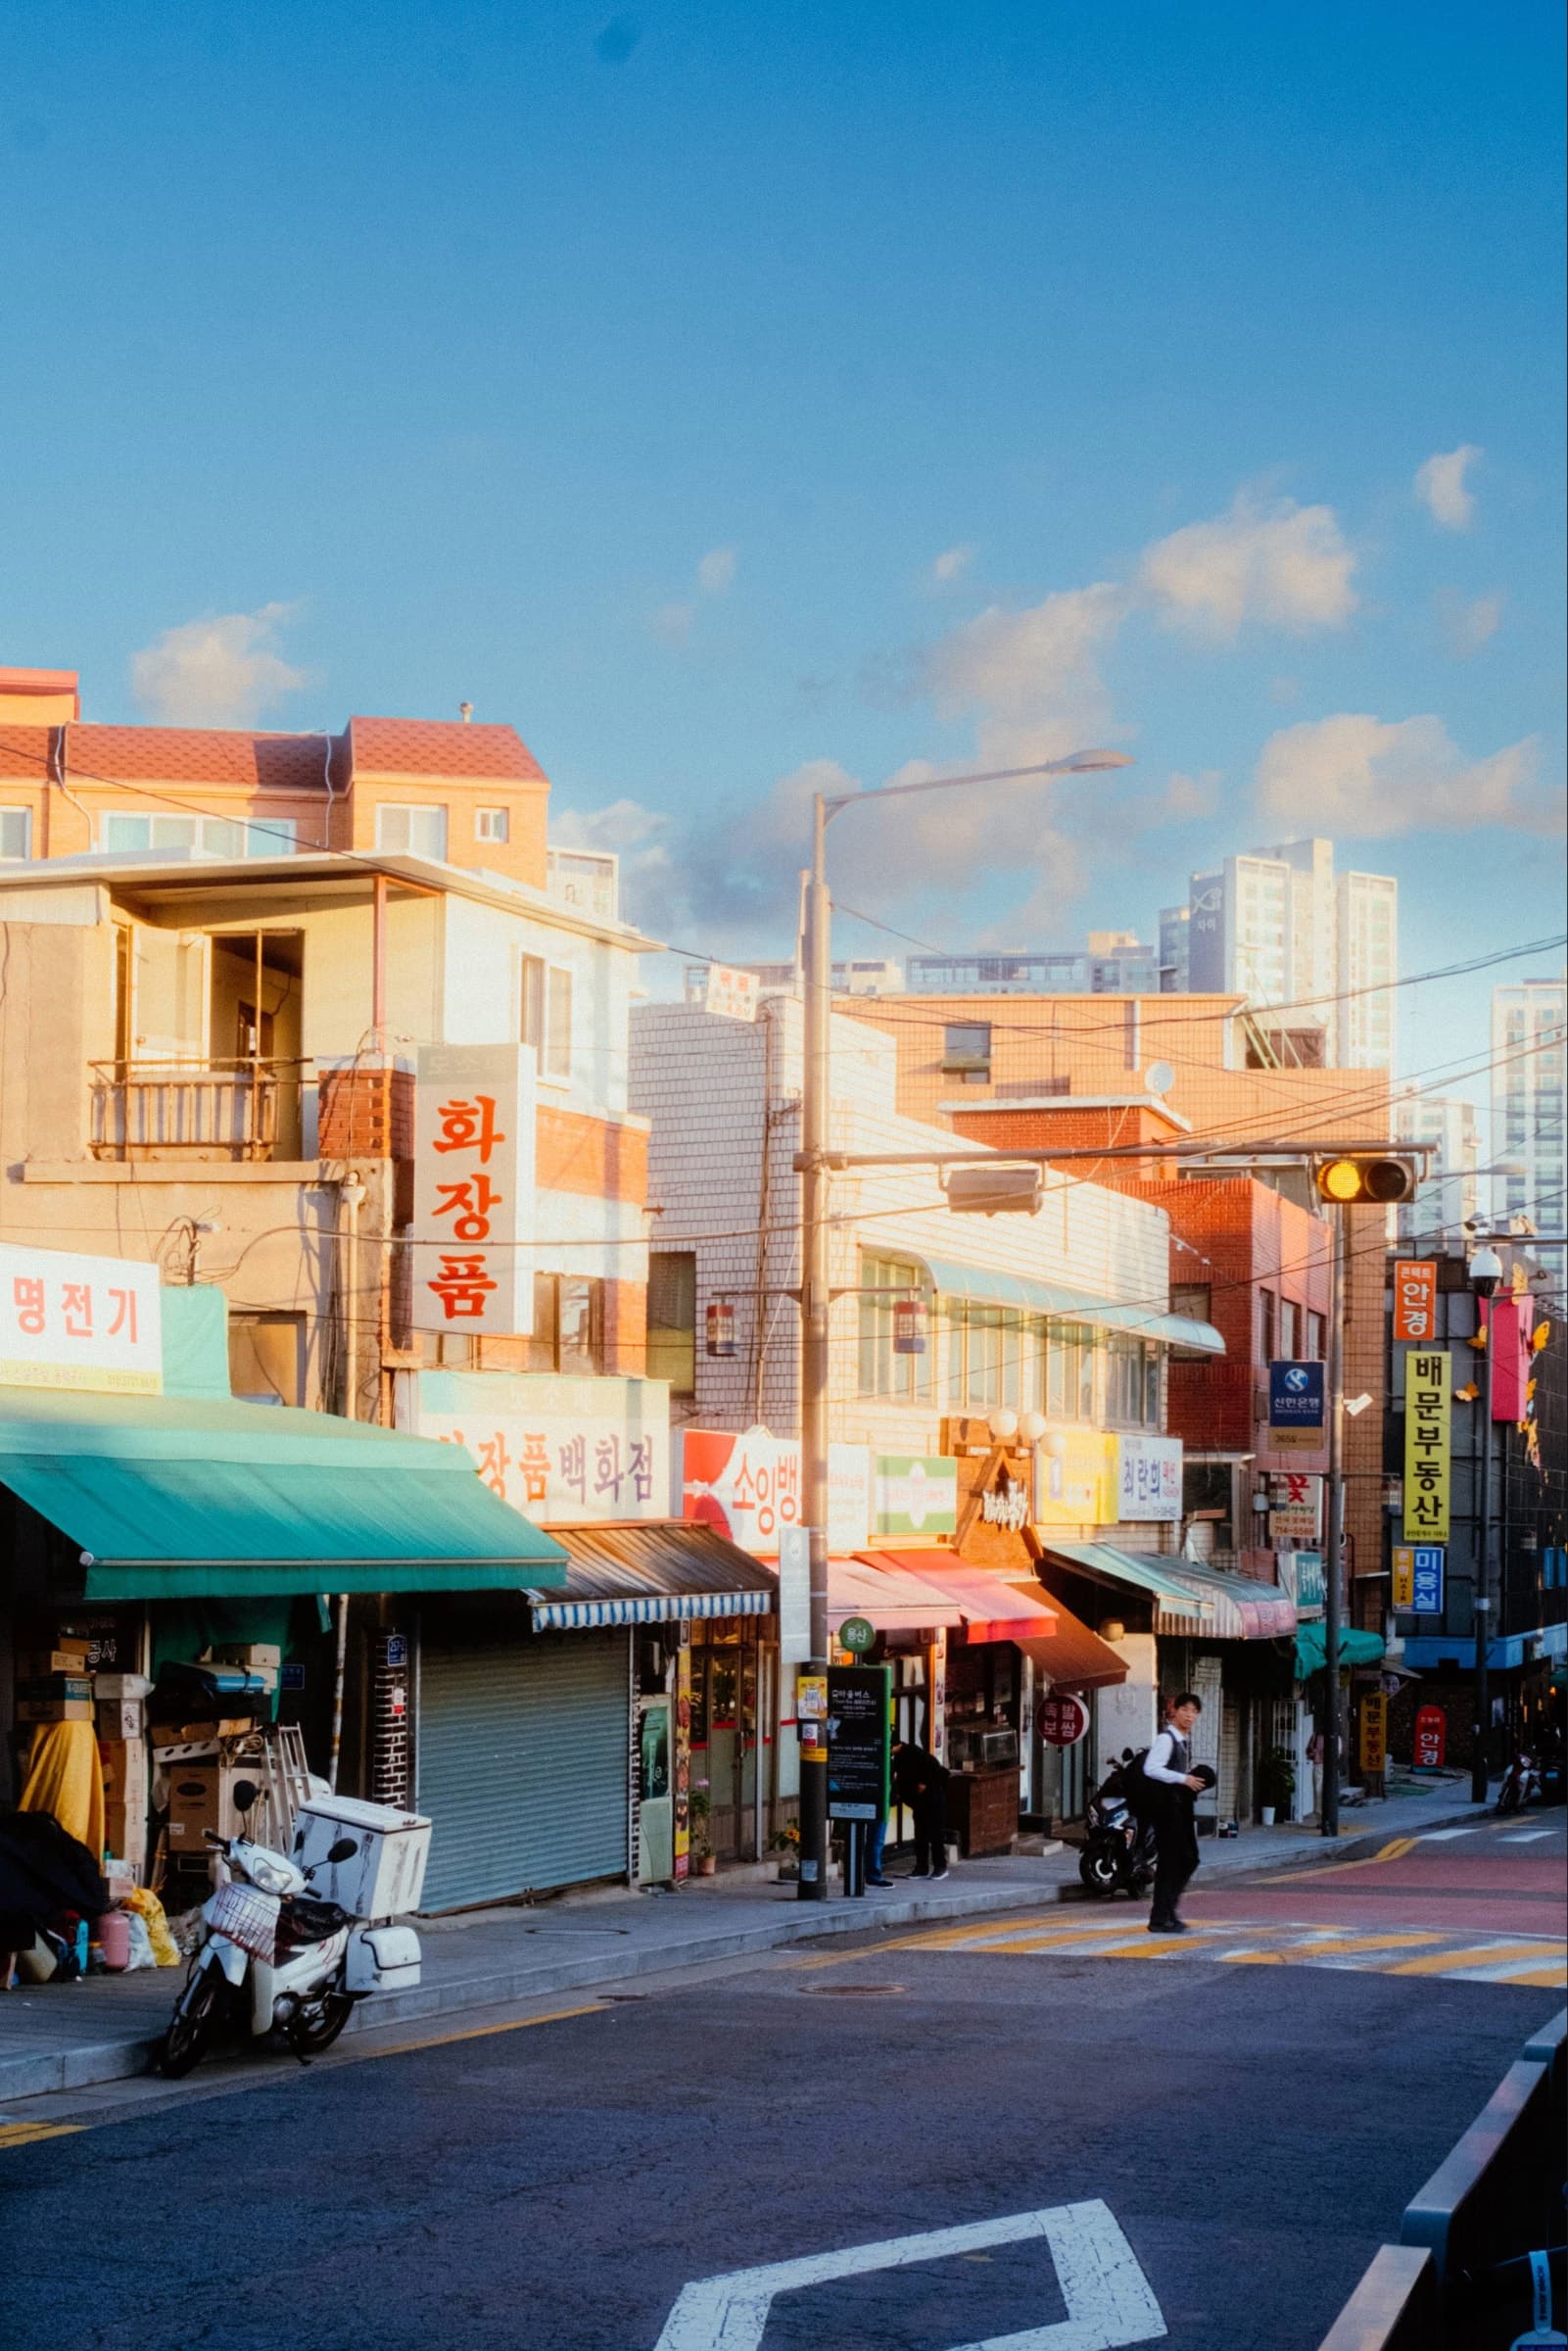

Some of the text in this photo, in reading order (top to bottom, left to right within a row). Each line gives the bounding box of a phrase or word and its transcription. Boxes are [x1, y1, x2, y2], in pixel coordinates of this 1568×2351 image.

[428, 1094, 505, 1319] 화장품
[14, 1276, 138, 1344] 명전기
[1402, 1282, 1430, 1336] 안경
[1274, 1396, 1319, 1409] 신한은행
[1412, 1356, 1444, 1526] 배문부동산
[732, 1452, 803, 1536] 소잉뱅
[1287, 1473, 1310, 1504] 꽃
[1414, 1552, 1438, 1609] 미용실
[1042, 1719, 1076, 1738] 보쌈
[1044, 1702, 1076, 1719] 족발
[1419, 1732, 1440, 1765] 안경
